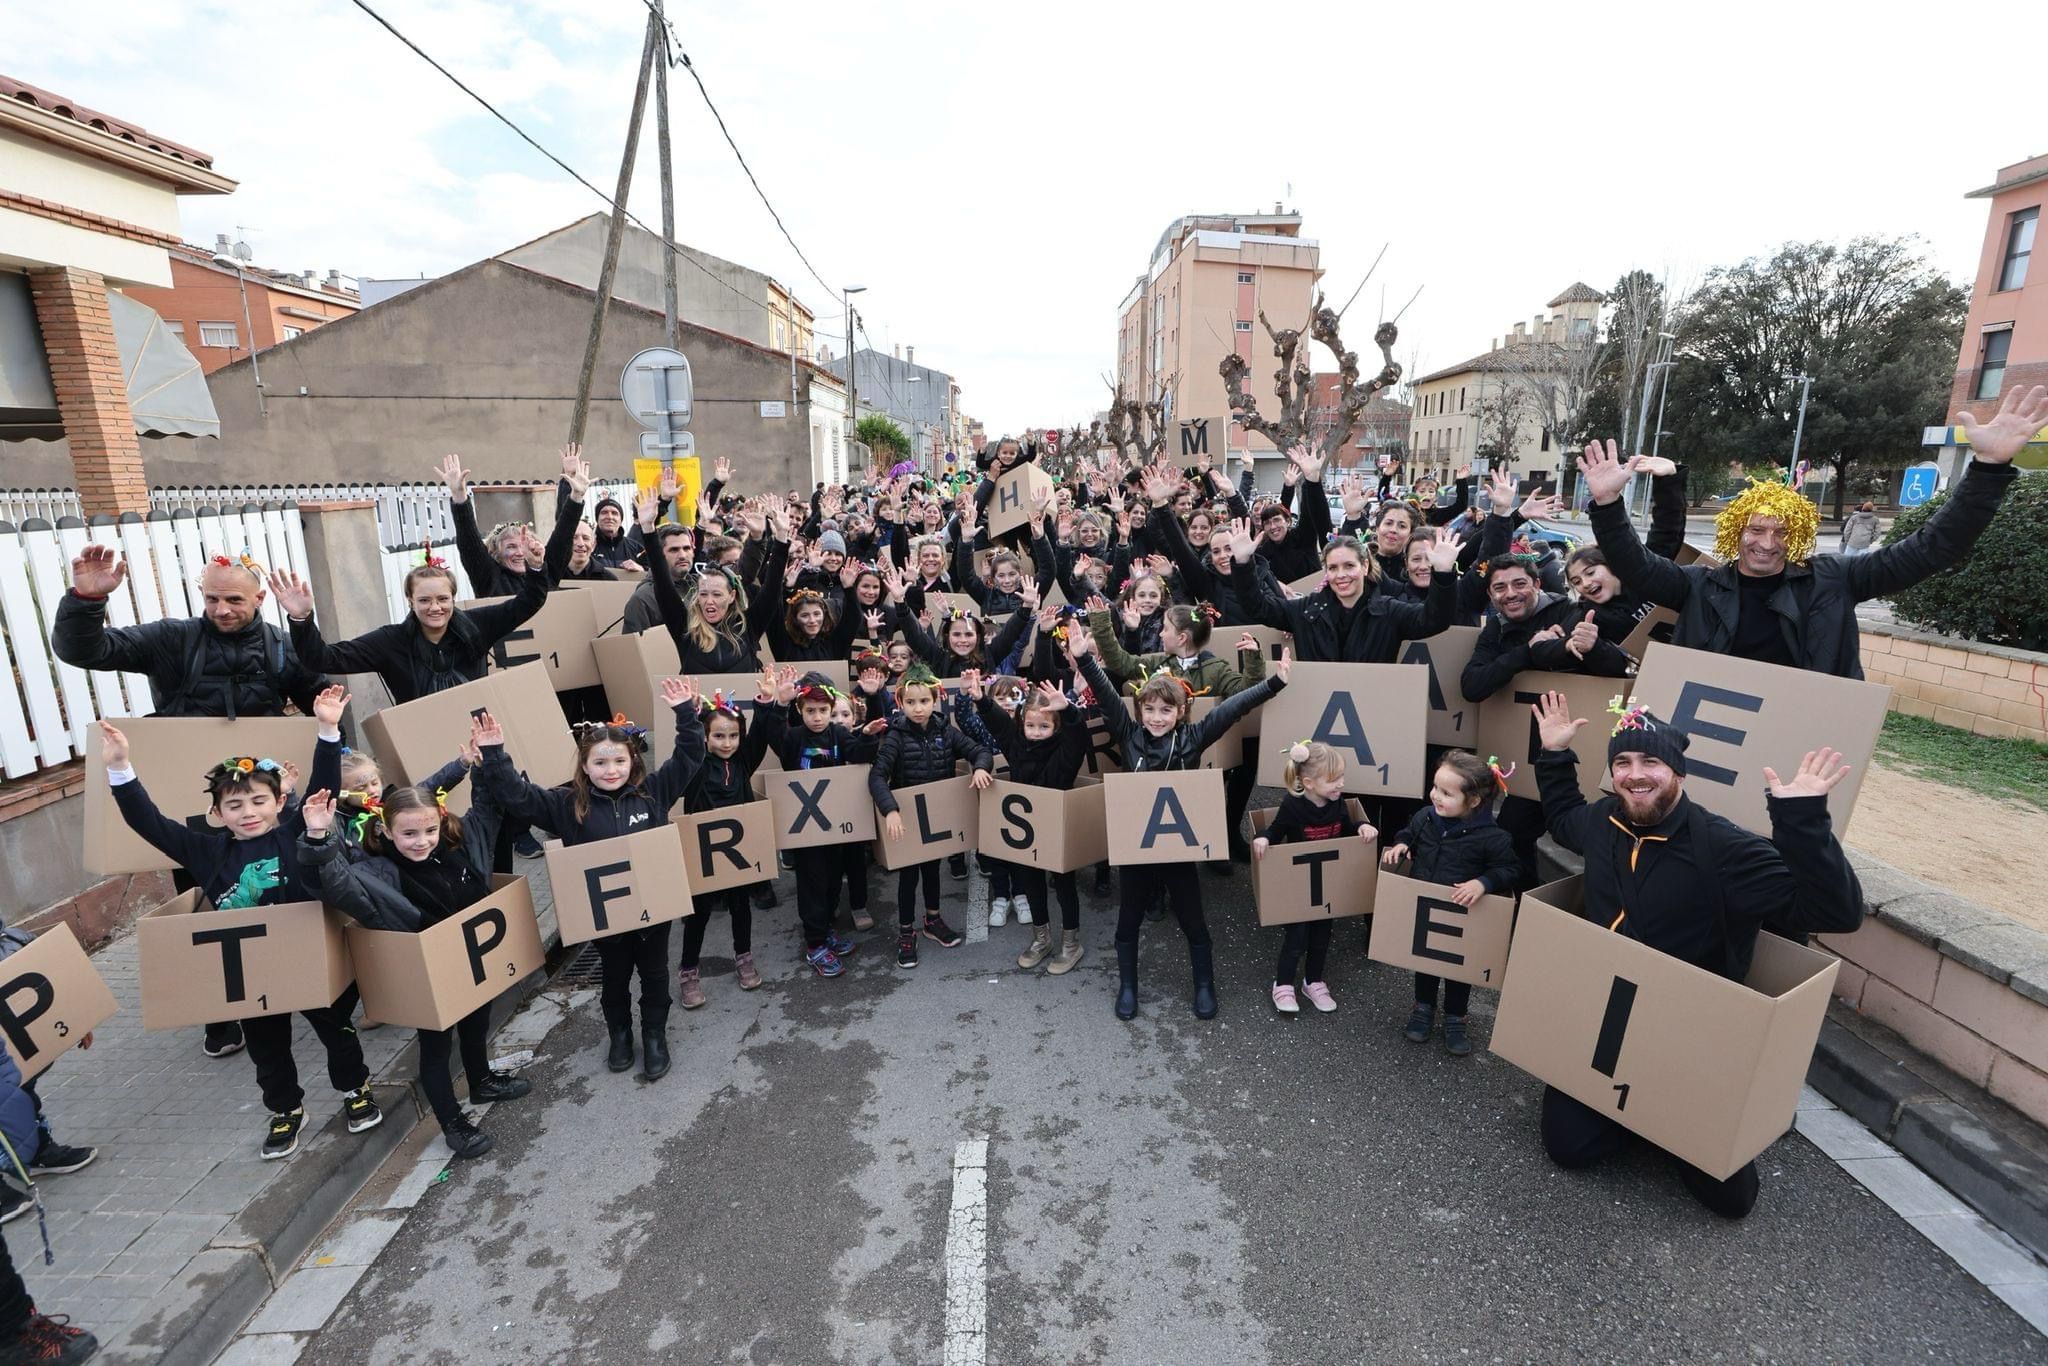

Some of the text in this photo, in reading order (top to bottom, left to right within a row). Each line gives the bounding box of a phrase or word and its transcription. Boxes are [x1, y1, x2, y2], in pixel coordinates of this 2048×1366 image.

[1181, 426, 1208, 455] M
[1000, 480, 1018, 513] H
[549, 651, 559, 668] 1
[1401, 642, 1464, 731] A 1
[1311, 691, 1390, 786] A 1
[1669, 681, 1764, 786] E
[788, 779, 853, 835] X 10
[915, 793, 965, 844] L 1
[1000, 794, 1035, 850] S
[1031, 849, 1038, 861] 1
[1140, 787, 1210, 858] A 1
[697, 819, 761, 878] R 1
[1292, 850, 1339, 907] T
[1324, 902, 1331, 914] 1
[584, 860, 650, 931] F 4
[192, 923, 267, 1003] T
[257, 994, 268, 1010] 1
[462, 908, 516, 986] P 3
[1412, 895, 1491, 982] E 1
[0, 972, 69, 1061] P 3
[1591, 975, 1638, 1112] I 1
